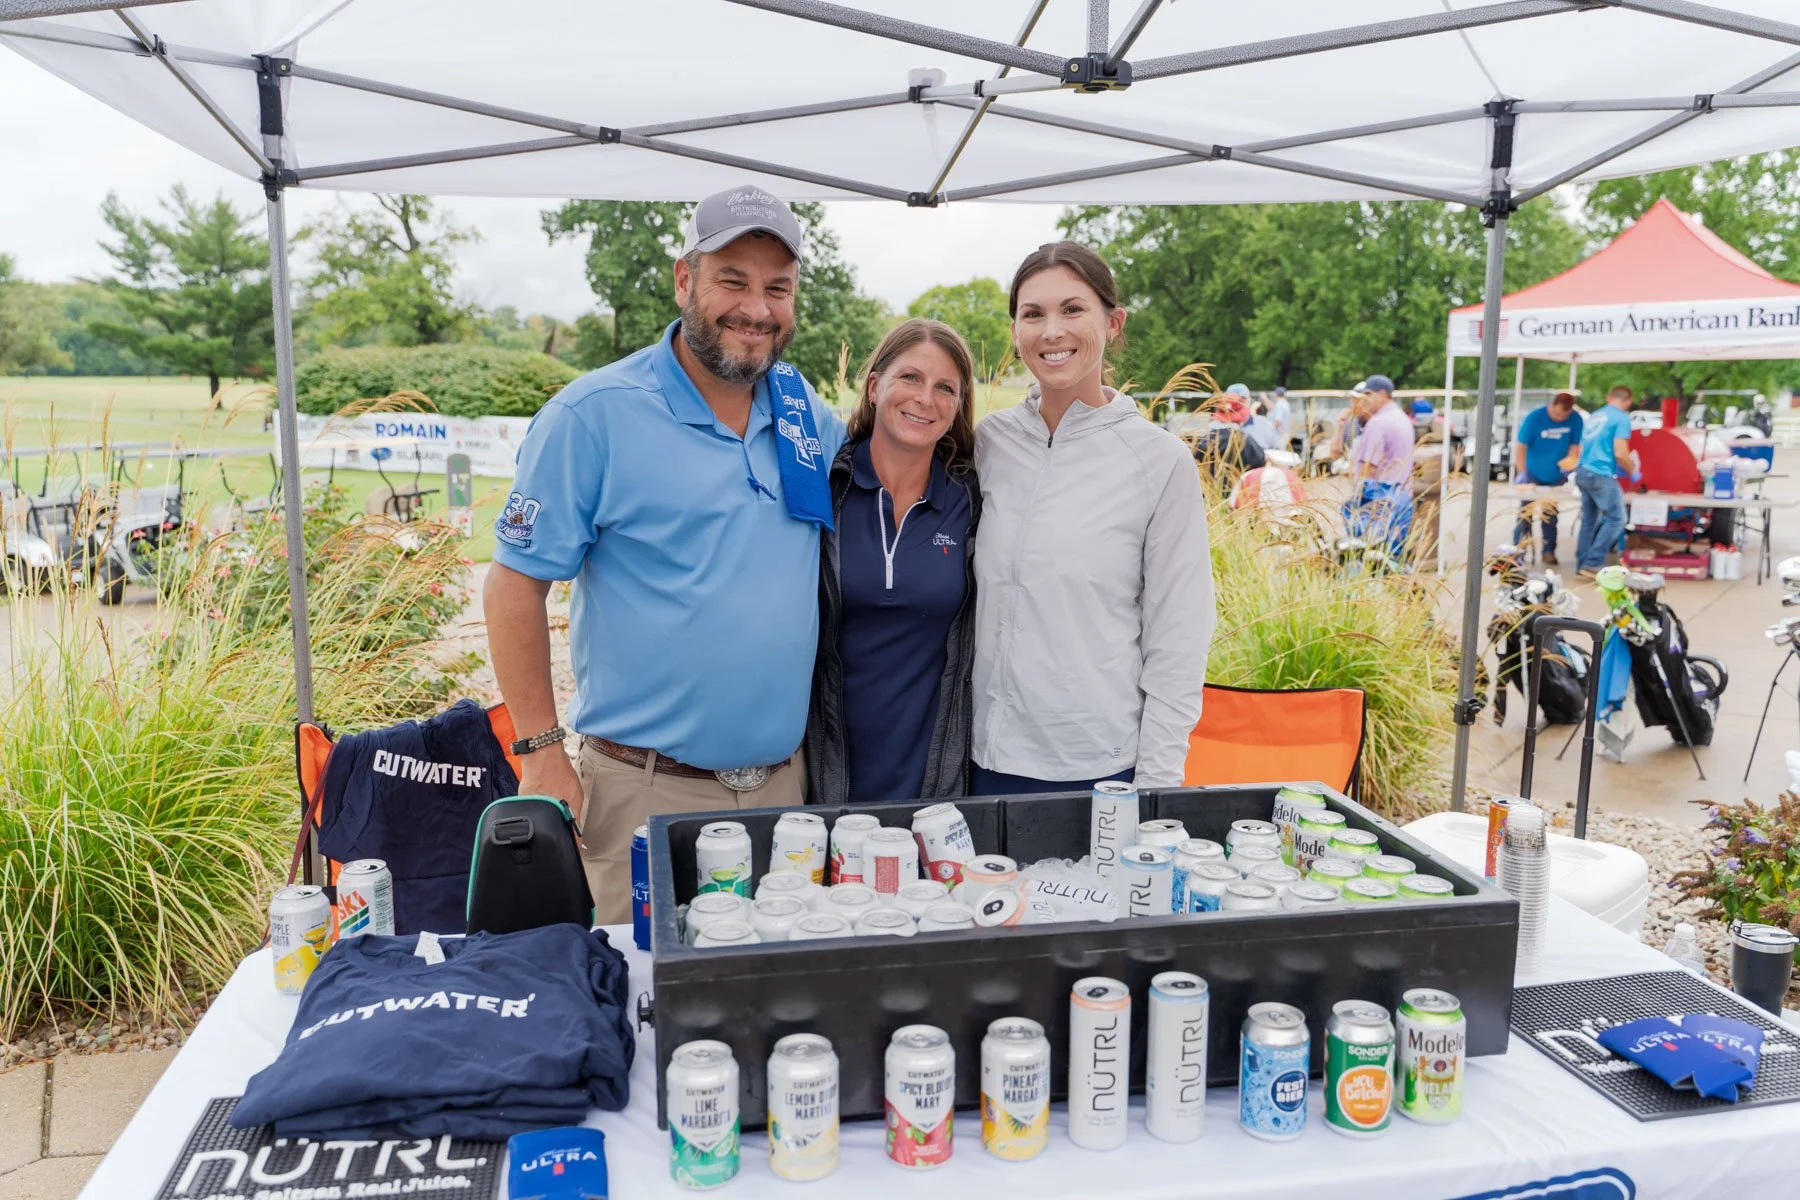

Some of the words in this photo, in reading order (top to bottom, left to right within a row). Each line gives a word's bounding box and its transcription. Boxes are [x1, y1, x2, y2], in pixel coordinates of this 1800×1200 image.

[1517, 317, 1613, 337] German
[1620, 307, 1740, 333] American
[375, 423, 446, 439] ROMAIN
[780, 421, 820, 452] SYCAMES
[504, 492, 542, 526] 30
[373, 749, 482, 788] CUTWATER
[1273, 804, 1301, 824] odelo
[1294, 832, 1325, 858] Mode
[1129, 877, 1152, 918] TRL
[299, 990, 529, 1040] CUTWATER
[1348, 1045, 1388, 1057] SONDER
[1408, 1028, 1464, 1054] Modelo
[1629, 1031, 1691, 1054] ULTRA
[1696, 1032, 1757, 1057] LTRA
[1009, 1061, 1047, 1073] CUTWATR
[793, 1076, 832, 1089] CUTWATR
[1003, 1068, 1048, 1088] PINEAP
[1276, 1079, 1304, 1093] FEST
[785, 1091, 816, 1106] LEMON
[915, 1096, 940, 1110] MARY
[1003, 1084, 1048, 1104] MARGAR
[695, 1098, 718, 1114] LIME
[521, 1151, 598, 1172] ULTRA
